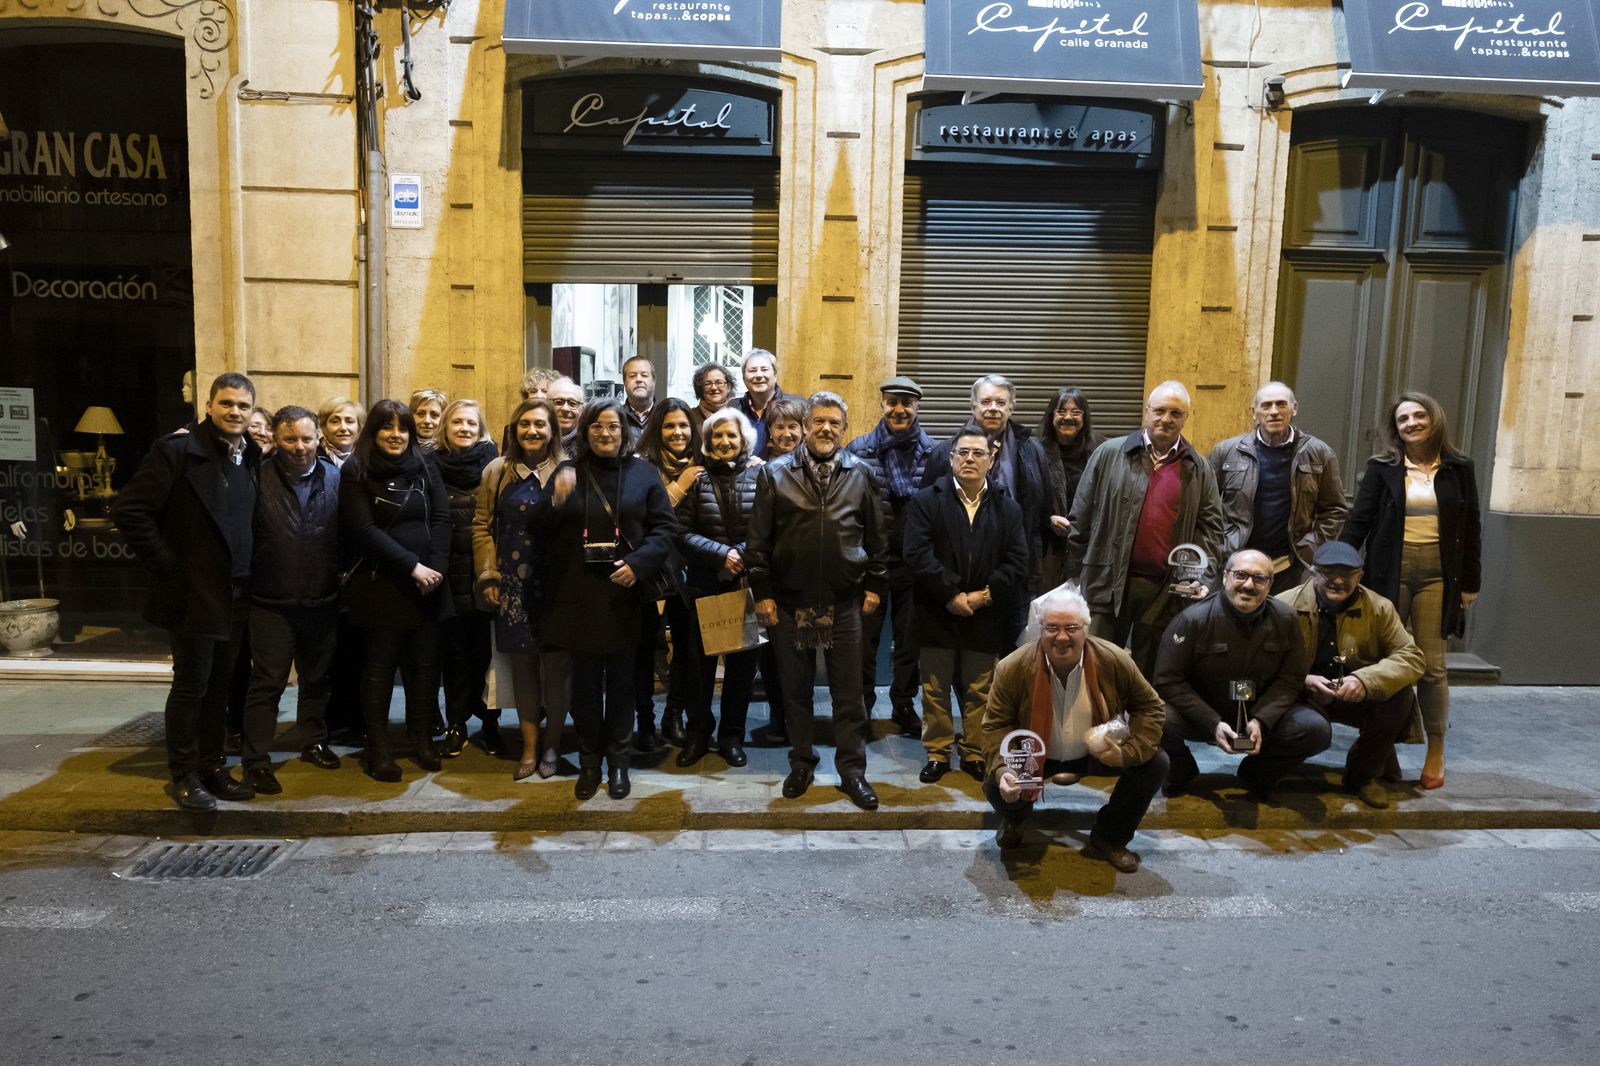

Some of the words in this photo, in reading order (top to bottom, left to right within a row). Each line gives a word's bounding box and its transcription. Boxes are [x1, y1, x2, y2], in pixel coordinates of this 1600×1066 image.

[652, 2, 731, 12] restaurante
[967, 1, 1149, 53] Capitol
[1387, 1, 1565, 51] Capitol
[1060, 38, 1090, 48] calle
[1094, 38, 1149, 49] Granada
[1490, 38, 1568, 48] restaurante
[563, 92, 732, 145] Capitol
[83, 131, 168, 180] CASA
[84, 187, 168, 207] artesano
[12, 270, 158, 301] Decoración
[58, 535, 88, 558] de
